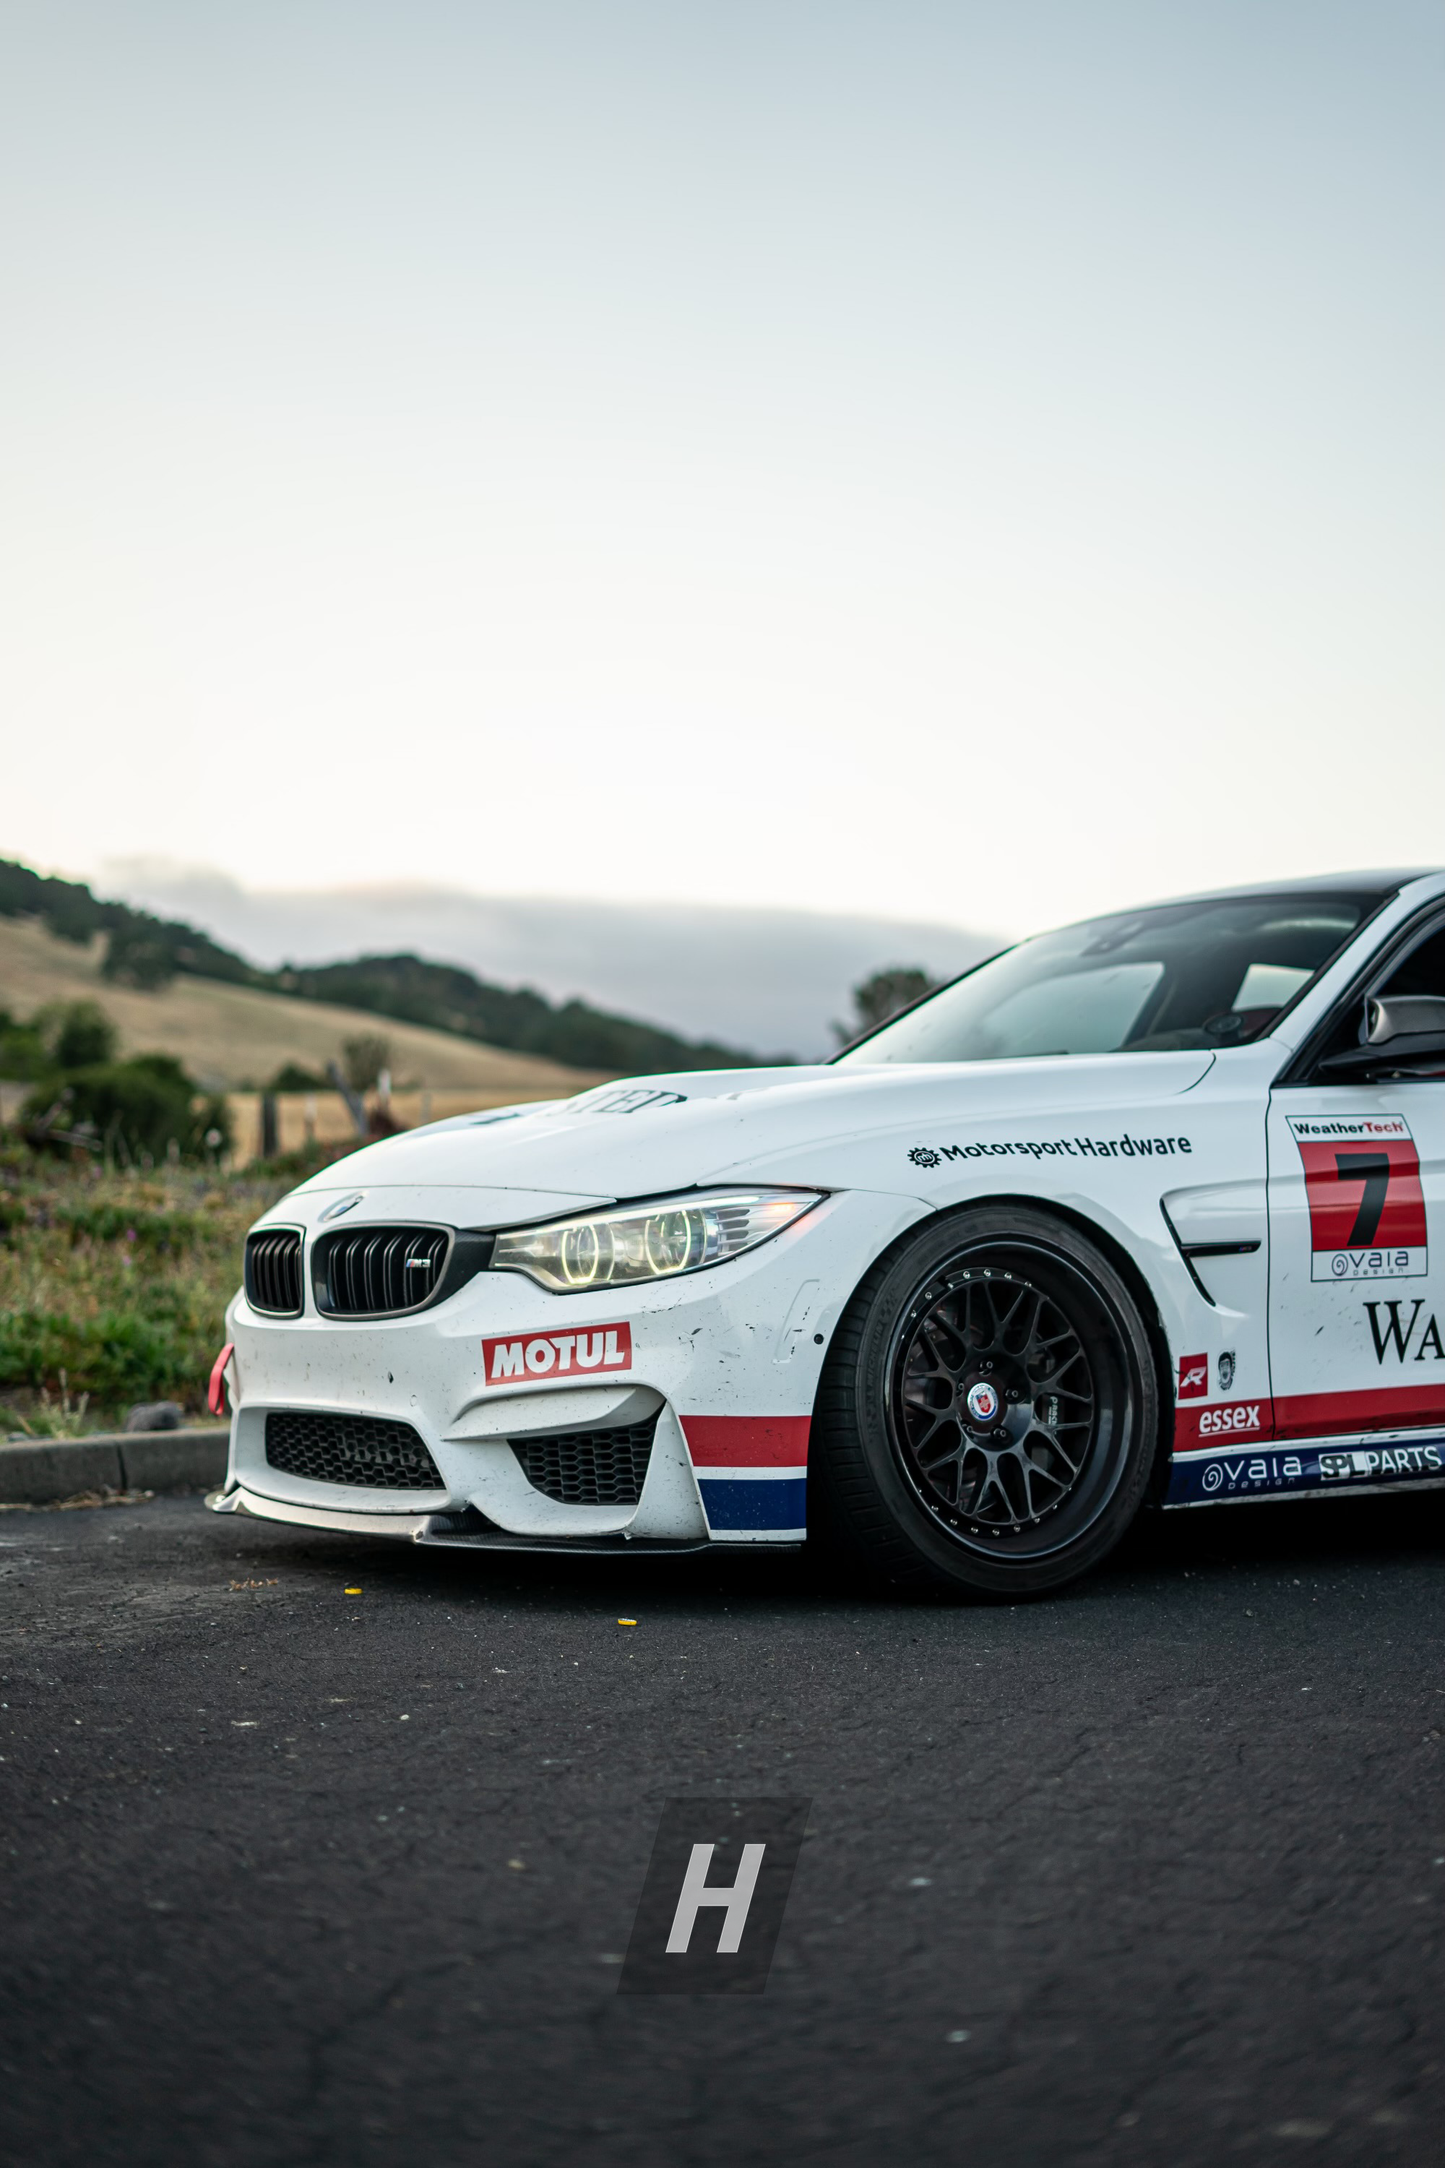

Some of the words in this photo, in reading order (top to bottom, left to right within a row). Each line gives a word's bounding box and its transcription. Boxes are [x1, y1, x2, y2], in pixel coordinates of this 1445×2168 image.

[1294, 1121, 1403, 1135] WeatherTech
[939, 1139, 1078, 1161] Motorsport
[1074, 1133, 1193, 1157] Hardware
[1334, 1153, 1390, 1246] 7
[491, 1330, 625, 1379] MOTUL
[1199, 1405, 1261, 1434] essex
[1366, 1446, 1442, 1475] PARTS
